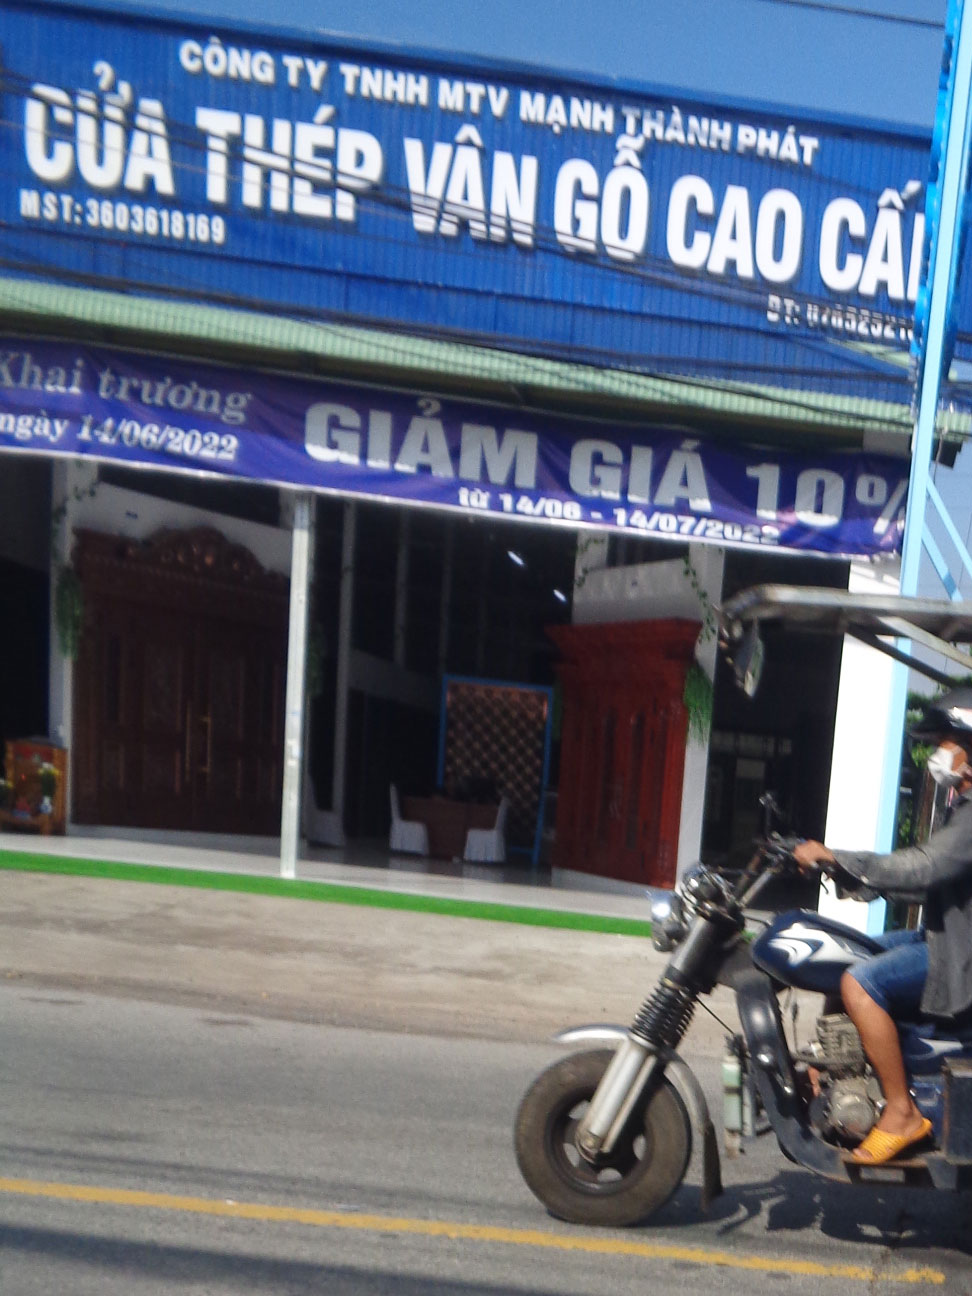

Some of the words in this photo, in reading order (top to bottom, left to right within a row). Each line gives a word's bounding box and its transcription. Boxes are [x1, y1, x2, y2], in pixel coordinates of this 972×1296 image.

[180, 36, 276, 84] CÔNG
[283, 57, 328, 92] TY
[340, 63, 429, 107] TNHH
[438, 79, 509, 118] MTV
[519, 90, 614, 136] MẠNH
[621, 104, 733, 151] THÀNH
[737, 125, 819, 167] PHÁT
[24, 61, 176, 196] CỬA
[195, 104, 385, 222] THÉP
[404, 124, 538, 248] VÂN
[553, 134, 650, 262] GỖ
[666, 174, 802, 283] CAO
[0, 409, 69, 442] ngày
[77, 414, 239, 461] 14/06/2022
[99, 367, 252, 425] trương
[304, 399, 538, 490] GIẢM
[568, 437, 713, 512] GIÁ
[499, 493, 582, 521] 14/06
